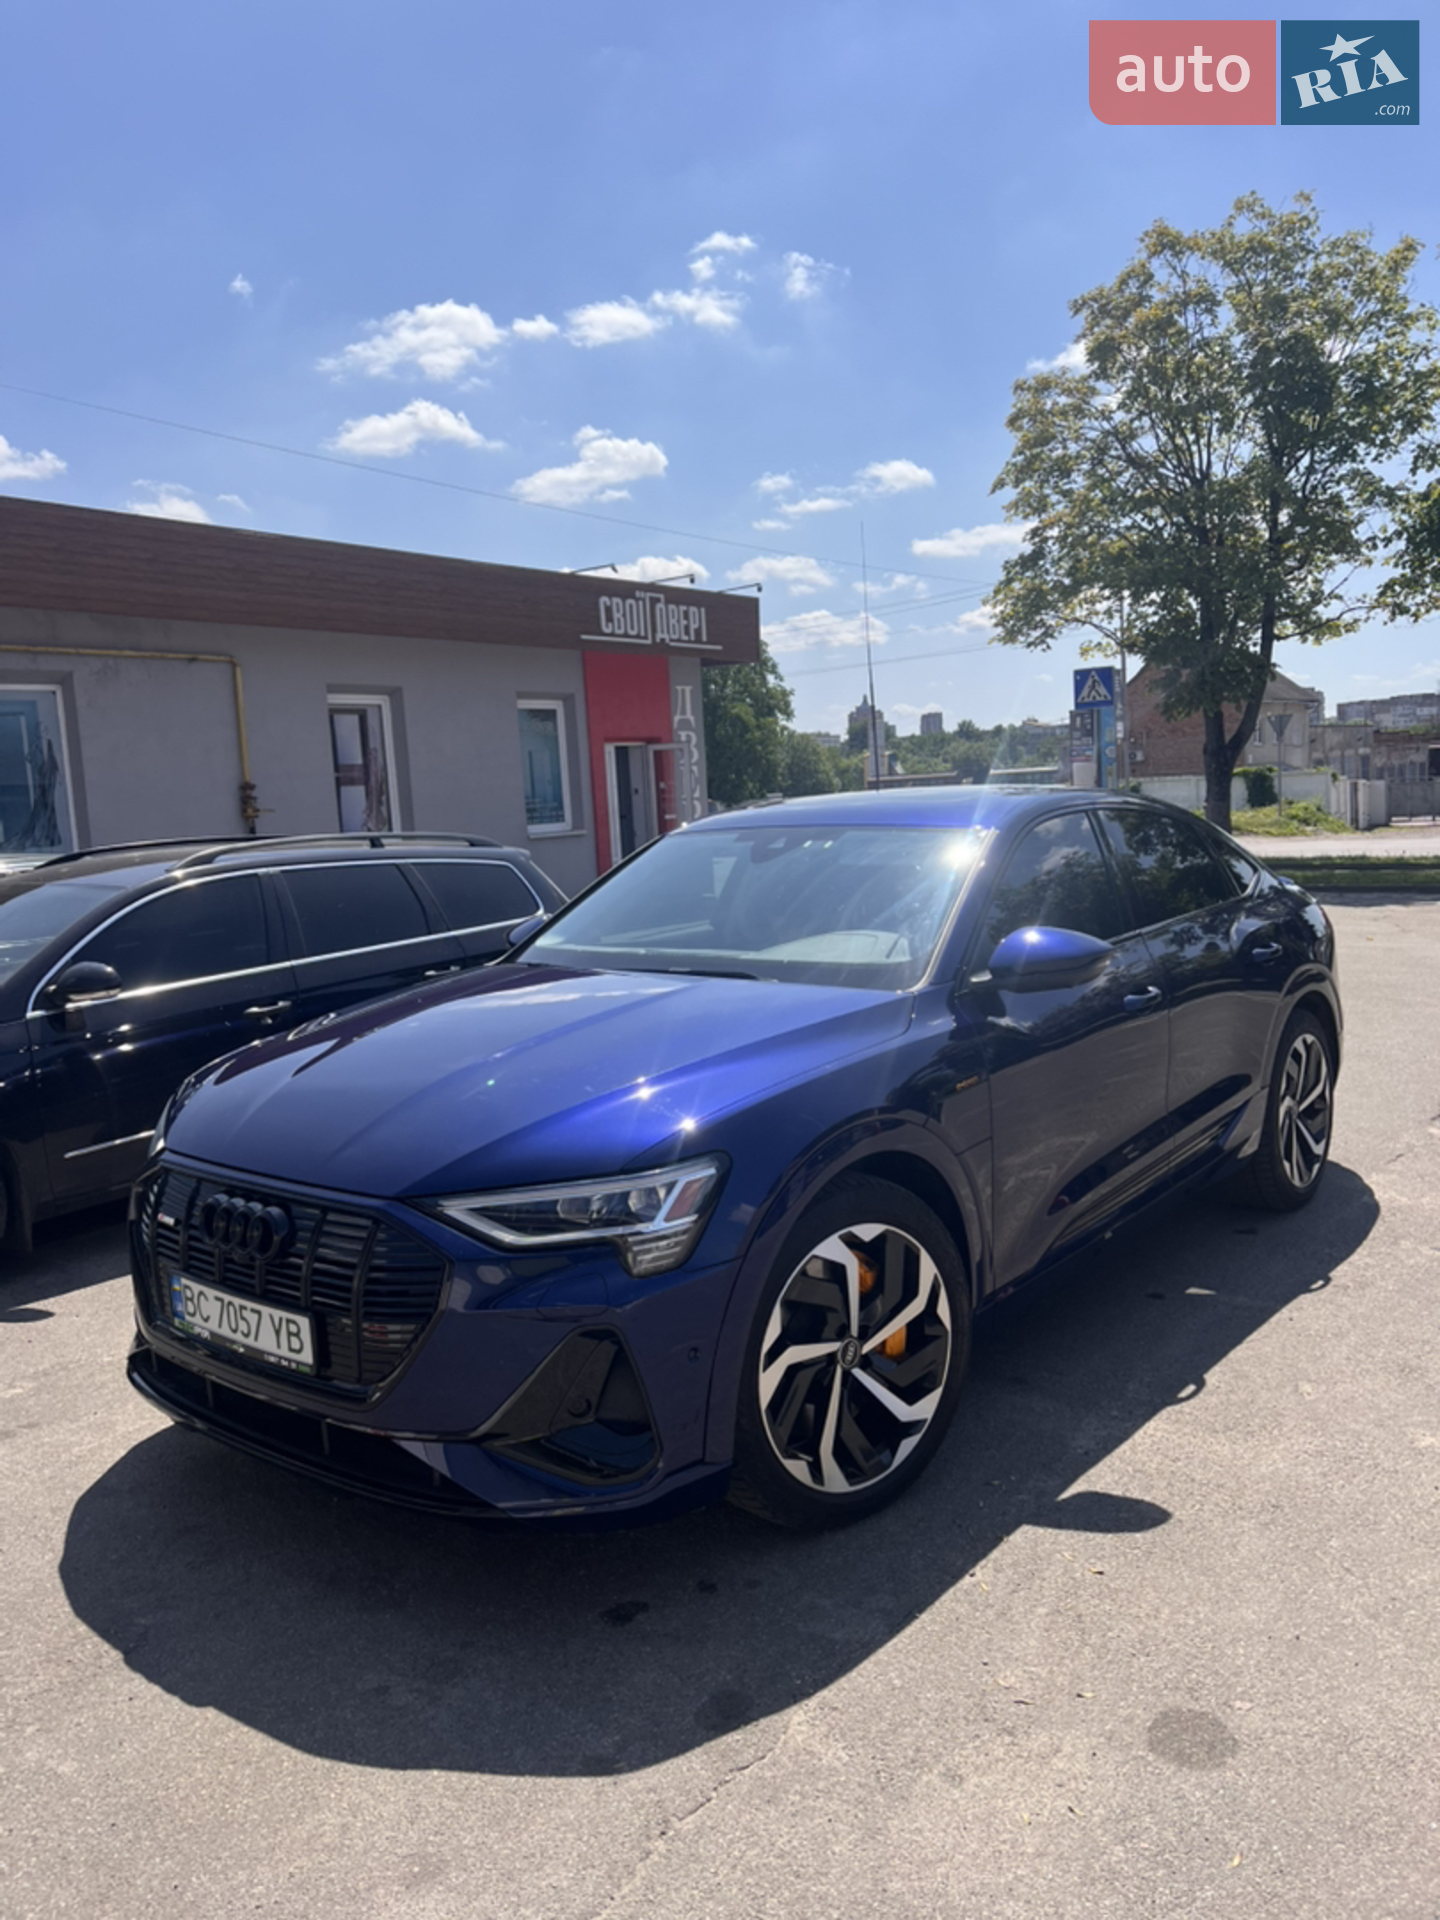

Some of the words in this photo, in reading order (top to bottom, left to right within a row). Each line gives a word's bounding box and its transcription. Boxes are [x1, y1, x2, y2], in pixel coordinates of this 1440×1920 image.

[599, 590, 645, 637] СВОЇ
[655, 603, 707, 643] ДВЕРІ
[184, 1284, 210, 1323] BC
[214, 1295, 263, 1342] 7057
[268, 1313, 304, 1354] YB
